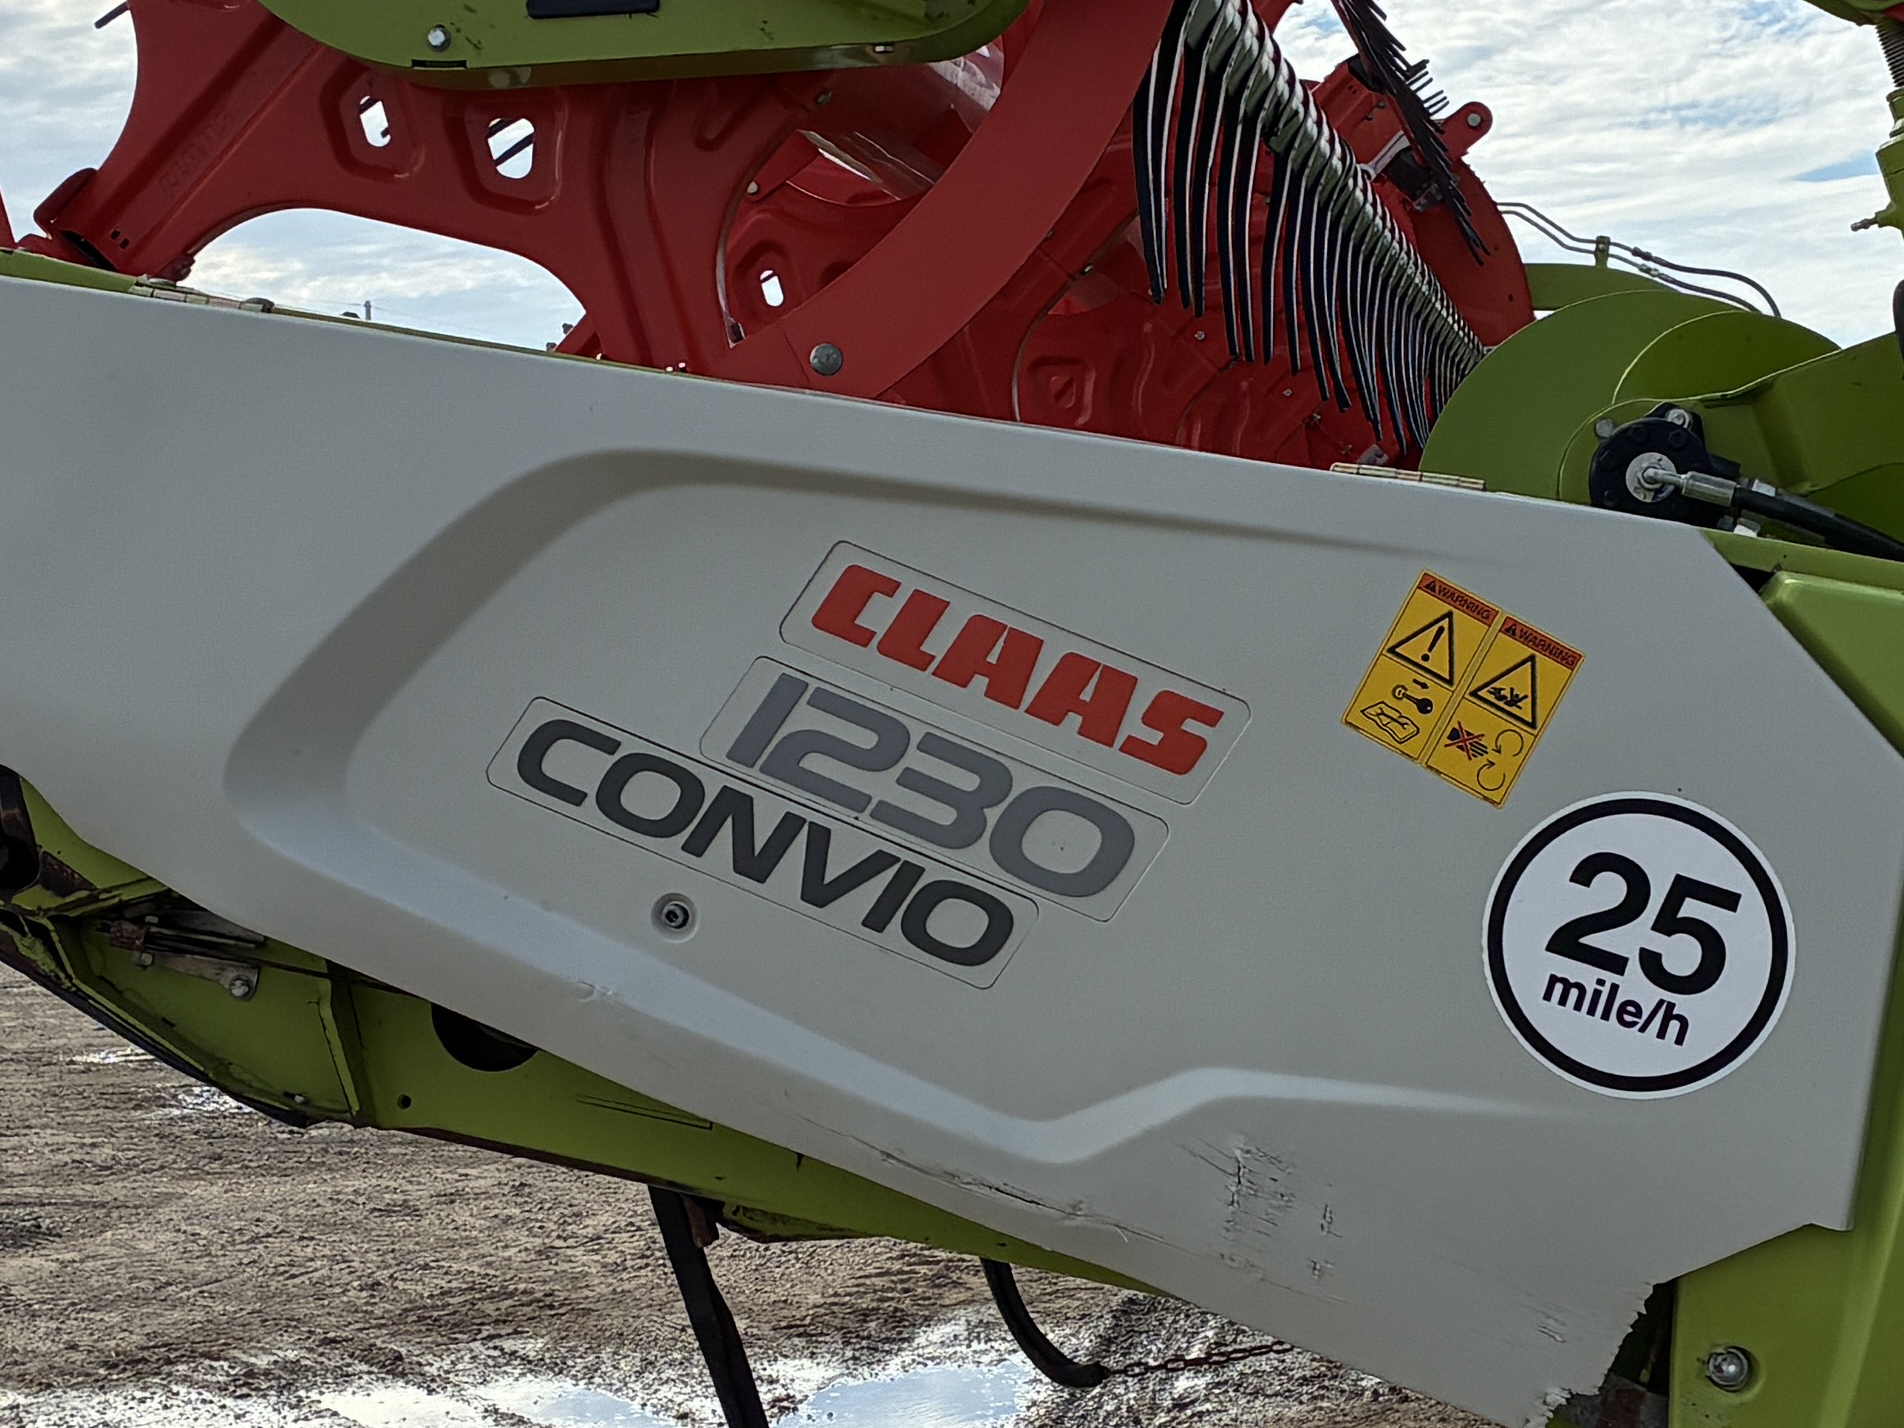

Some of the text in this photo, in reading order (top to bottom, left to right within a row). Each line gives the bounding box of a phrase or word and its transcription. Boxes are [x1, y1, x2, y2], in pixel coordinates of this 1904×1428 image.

[811, 564, 1225, 776] CLAAS
[1438, 584, 1492, 620] WARNING
[1519, 627, 1577, 668] WARNING
[516, 719, 1014, 966] CONVIO
[725, 672, 1135, 897] 1230
[1545, 852, 1742, 995] 25
[1542, 973, 1689, 1047] mile/h
